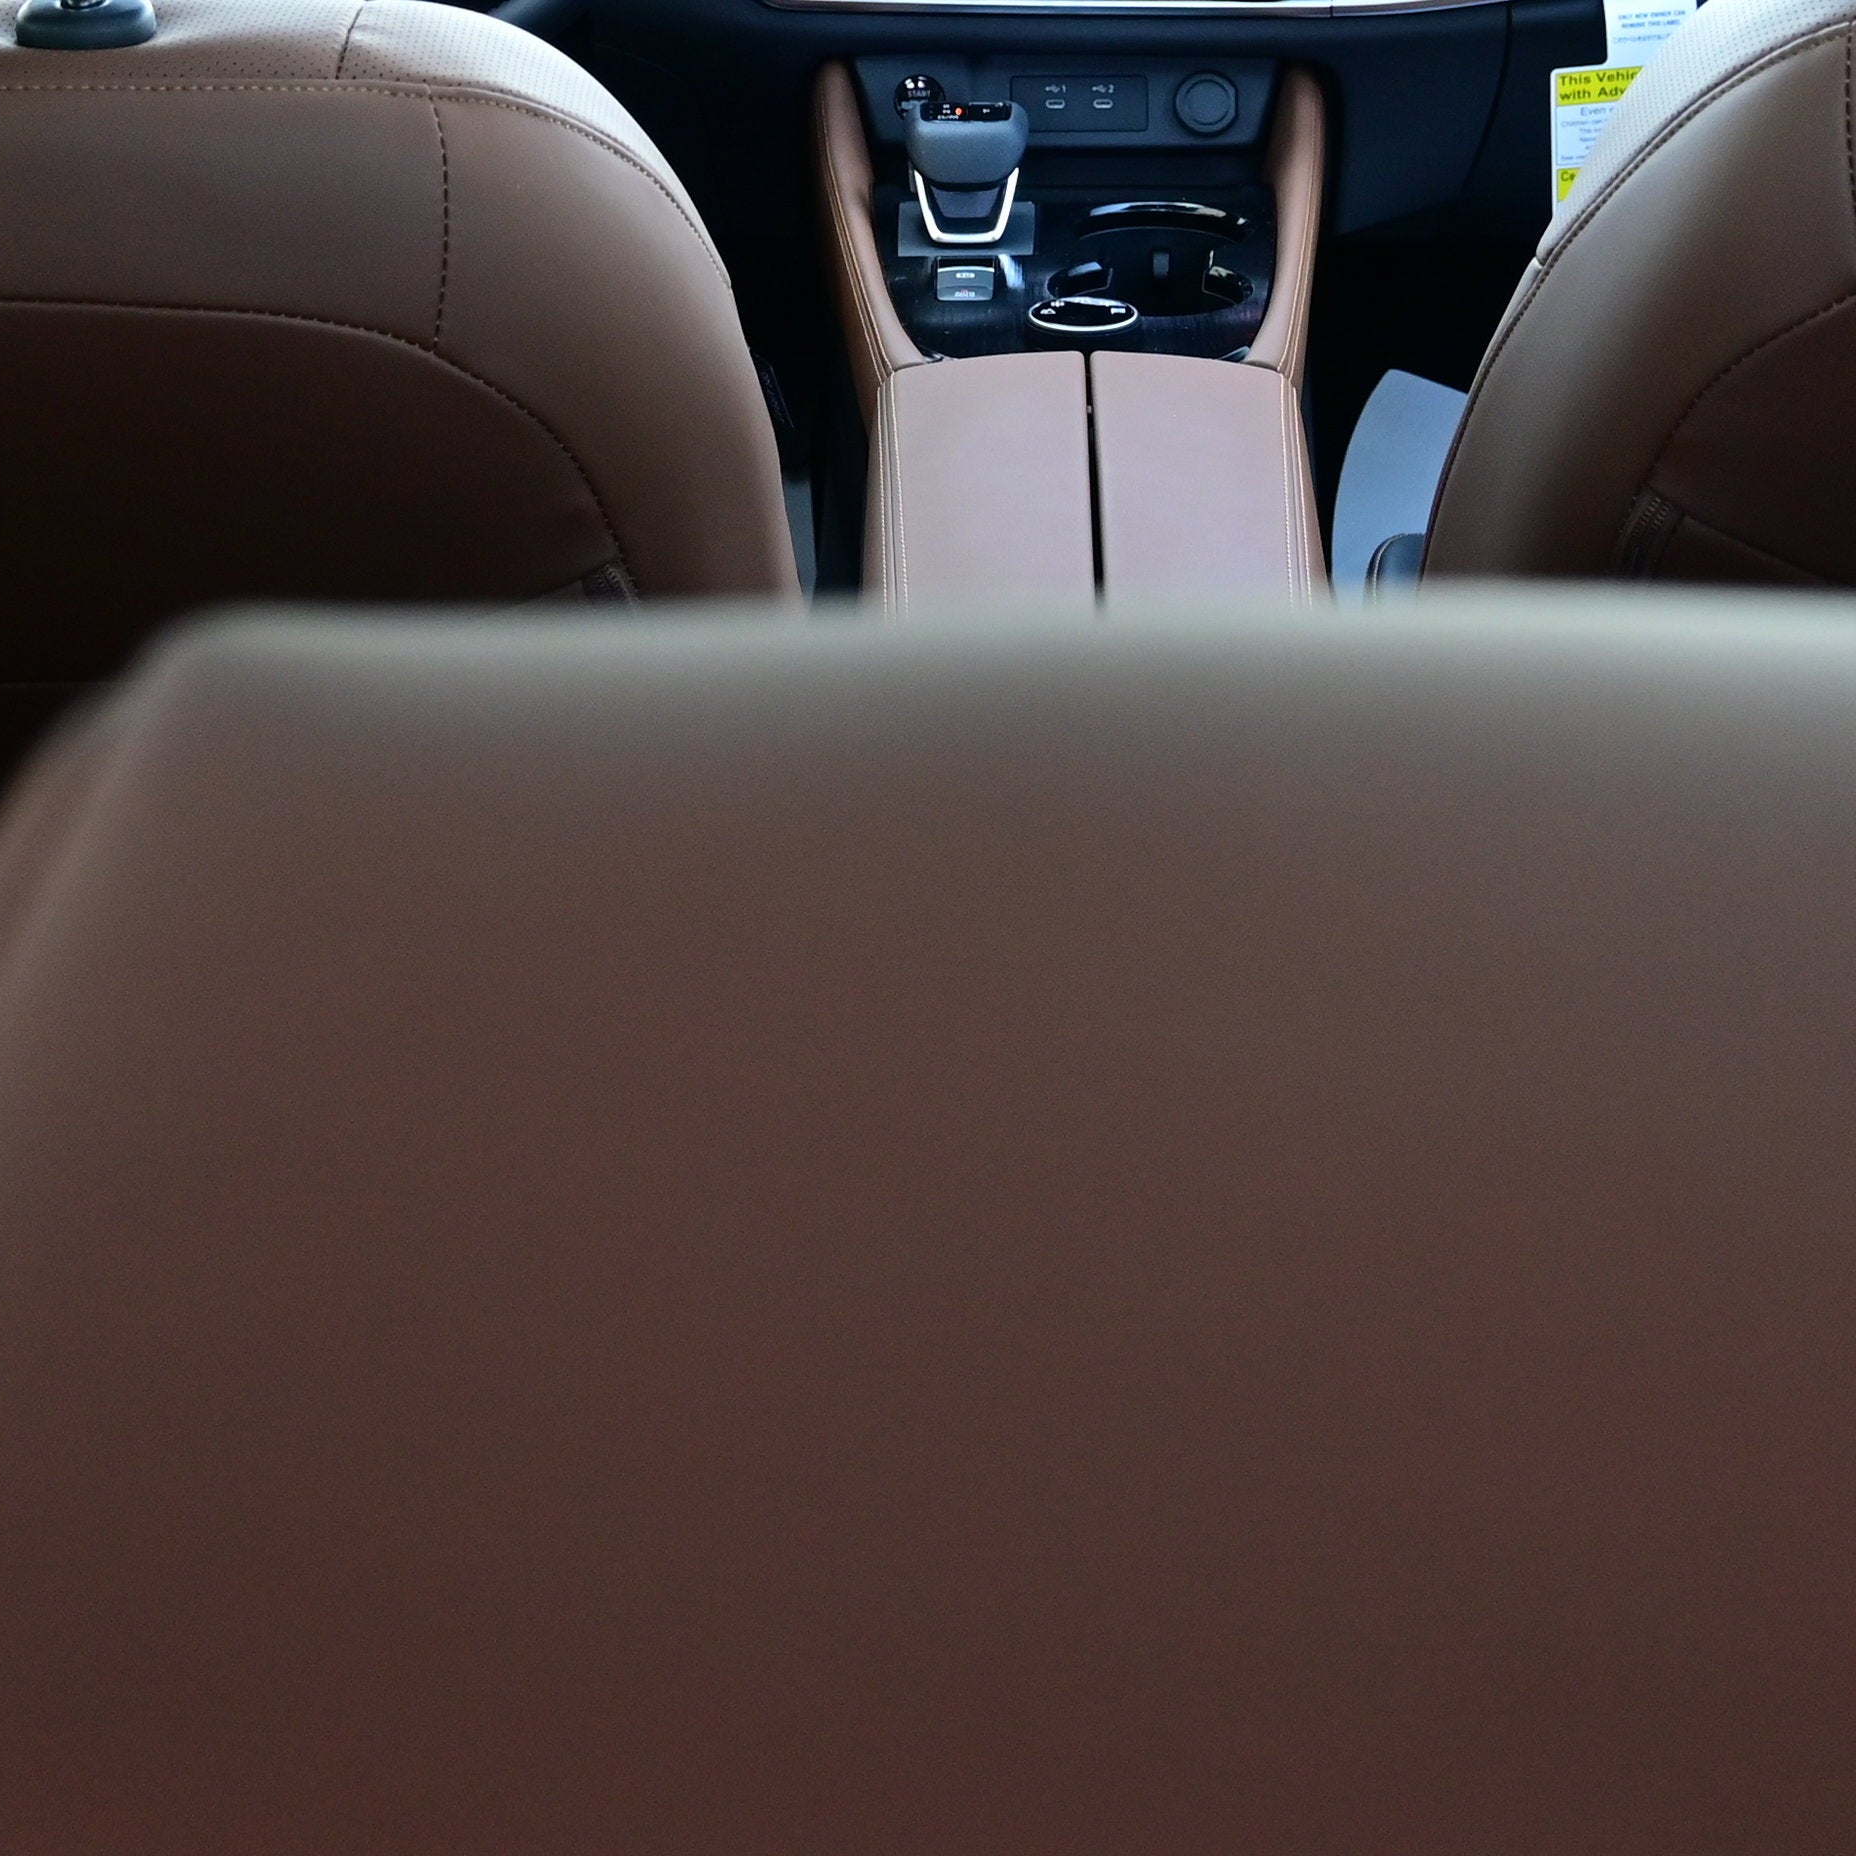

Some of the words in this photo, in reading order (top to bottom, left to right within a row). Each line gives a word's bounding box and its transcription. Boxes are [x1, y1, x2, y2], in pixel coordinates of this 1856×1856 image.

[1560, 74, 1591, 87] This
[1108, 84, 1115, 93] 2
[1560, 89, 1591, 101] with
[1581, 107, 1606, 117] Even
